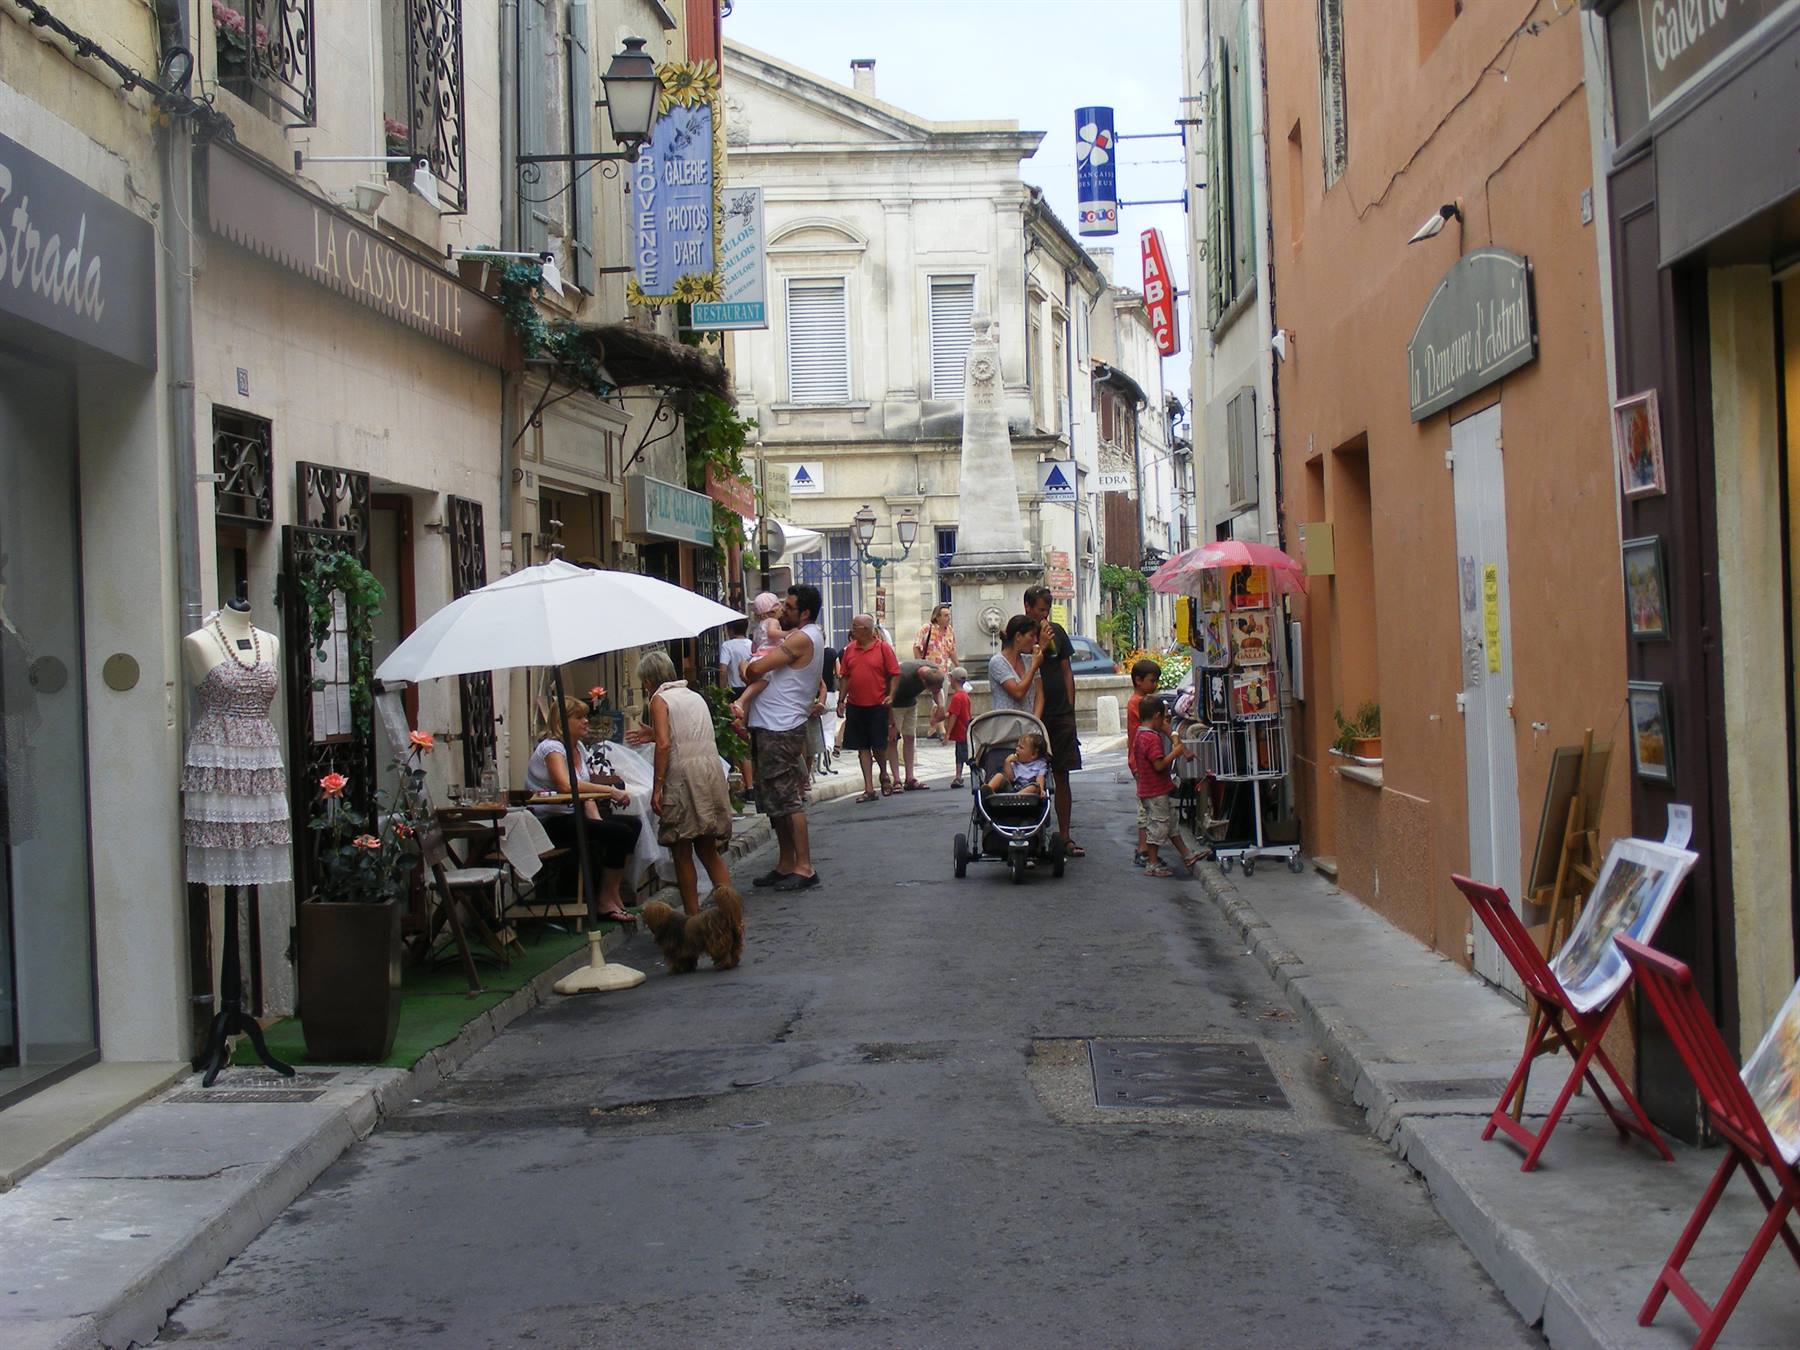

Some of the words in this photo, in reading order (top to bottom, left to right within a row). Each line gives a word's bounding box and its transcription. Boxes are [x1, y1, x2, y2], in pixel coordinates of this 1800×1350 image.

[665, 158, 708, 186] GALERIE
[666, 204, 709, 231] PHOTOS
[1079, 208, 1116, 222] LOTO
[673, 240, 704, 265] D'ART
[313, 208, 340, 278] LA
[346, 230, 462, 336] CASSOLETTE
[1141, 233, 1170, 350] TABAC
[696, 304, 761, 321] RESTAURANT
[1424, 330, 1472, 397] Demeure
[656, 485, 670, 519] LE
[672, 491, 712, 529] GAULOIS
